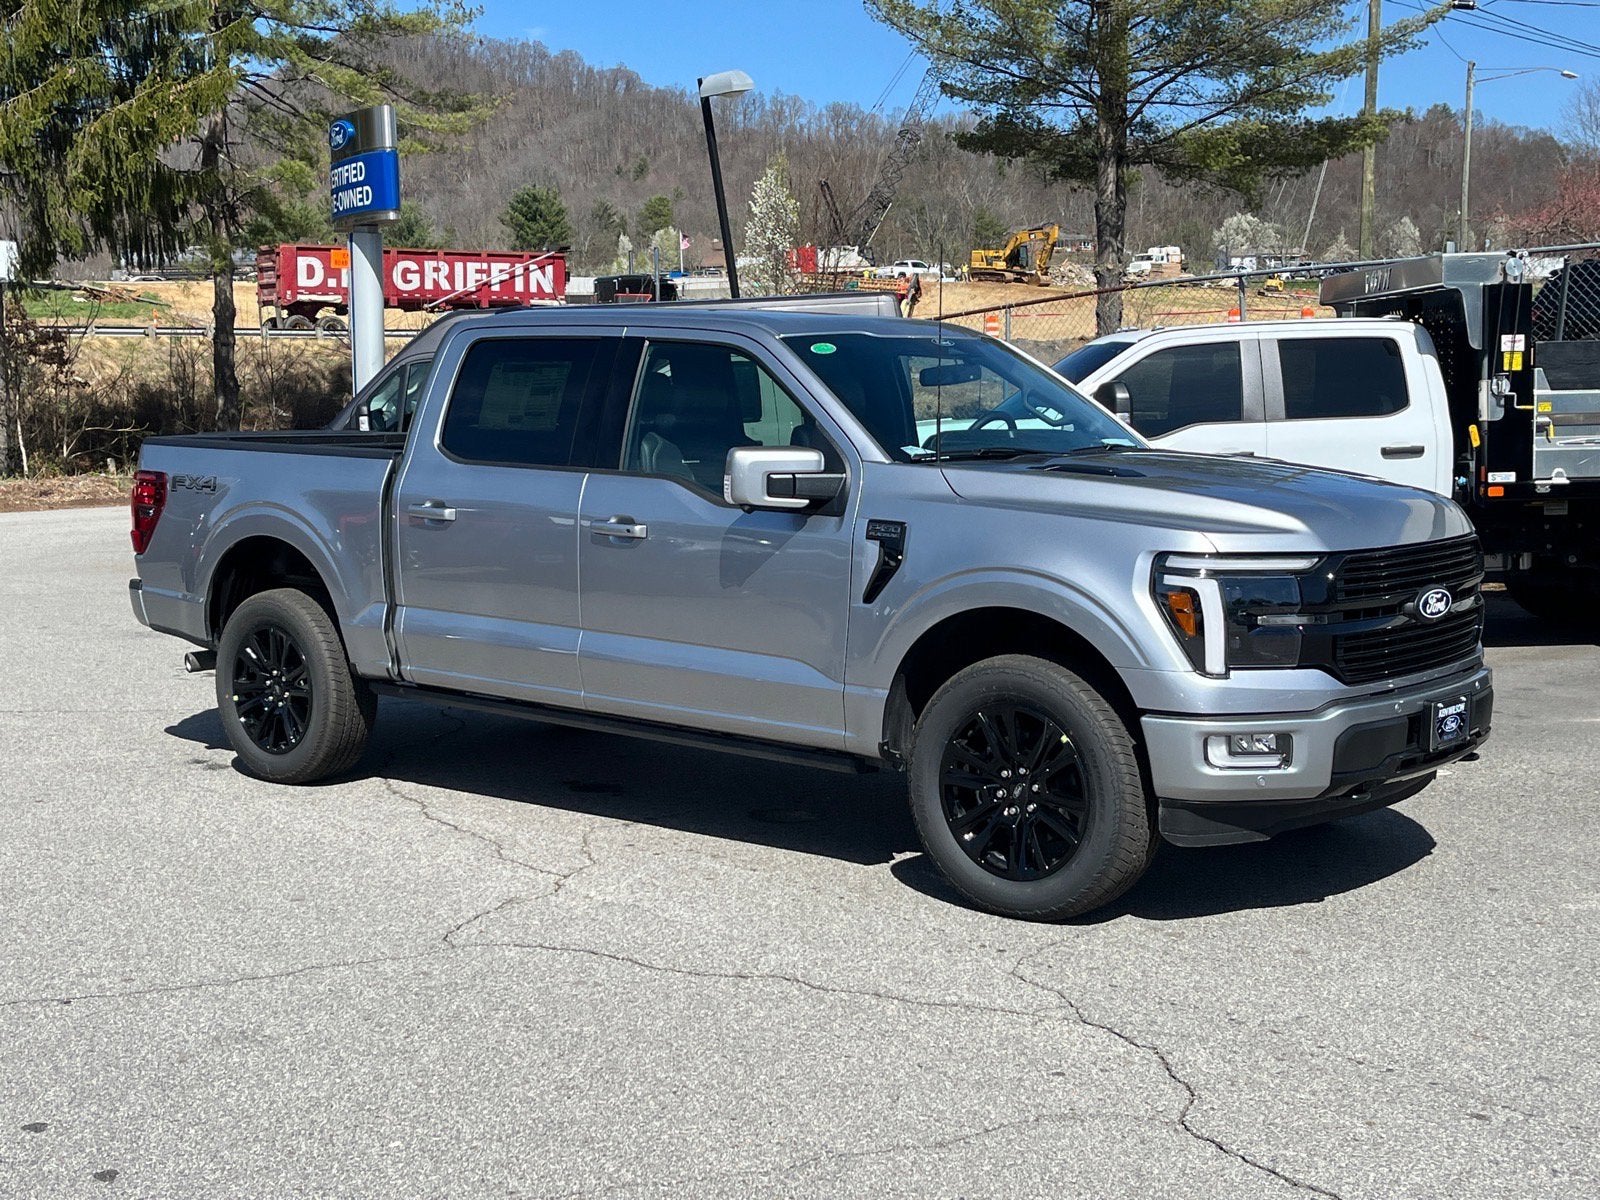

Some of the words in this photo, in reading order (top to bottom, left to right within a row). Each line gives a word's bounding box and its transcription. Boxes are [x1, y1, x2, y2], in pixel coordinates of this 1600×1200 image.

[330, 126, 344, 147] Ford
[331, 161, 365, 189] ERTIFIED
[331, 185, 373, 213] E-OWNED
[296, 256, 349, 288] D.
[392, 260, 554, 294] GRIFFIN
[171, 474, 217, 493] FX4
[1425, 592, 1447, 614] Ford
[1445, 717, 1458, 731] Ford
